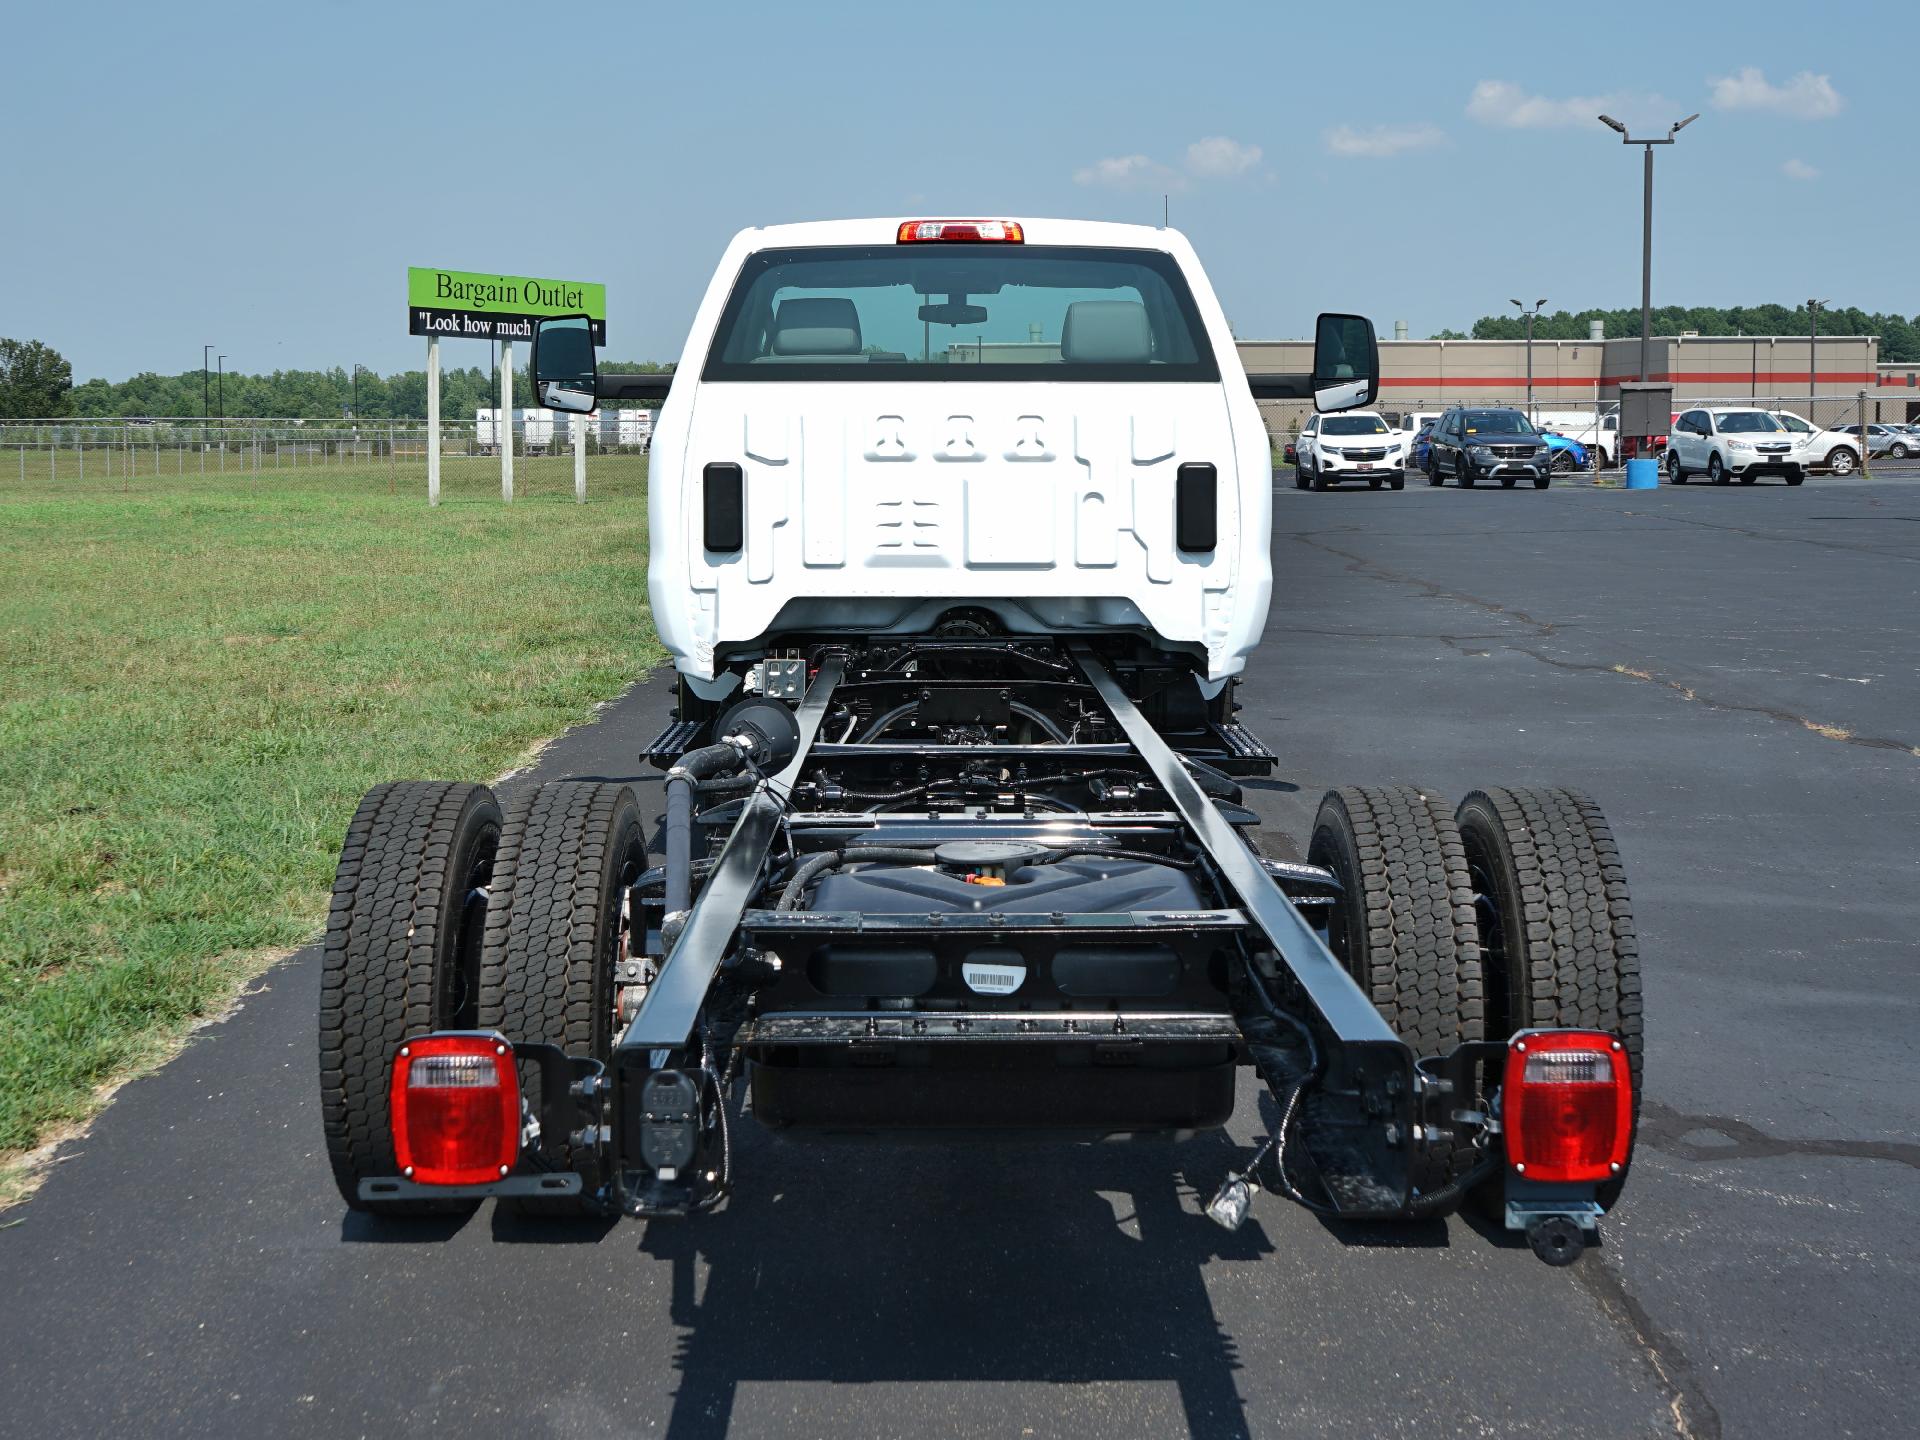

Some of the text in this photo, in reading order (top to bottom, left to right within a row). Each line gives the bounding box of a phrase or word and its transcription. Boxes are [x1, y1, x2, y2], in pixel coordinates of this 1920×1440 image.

[435, 273, 584, 309] Bargain Outlet
[419, 311, 531, 336] "Look how much
